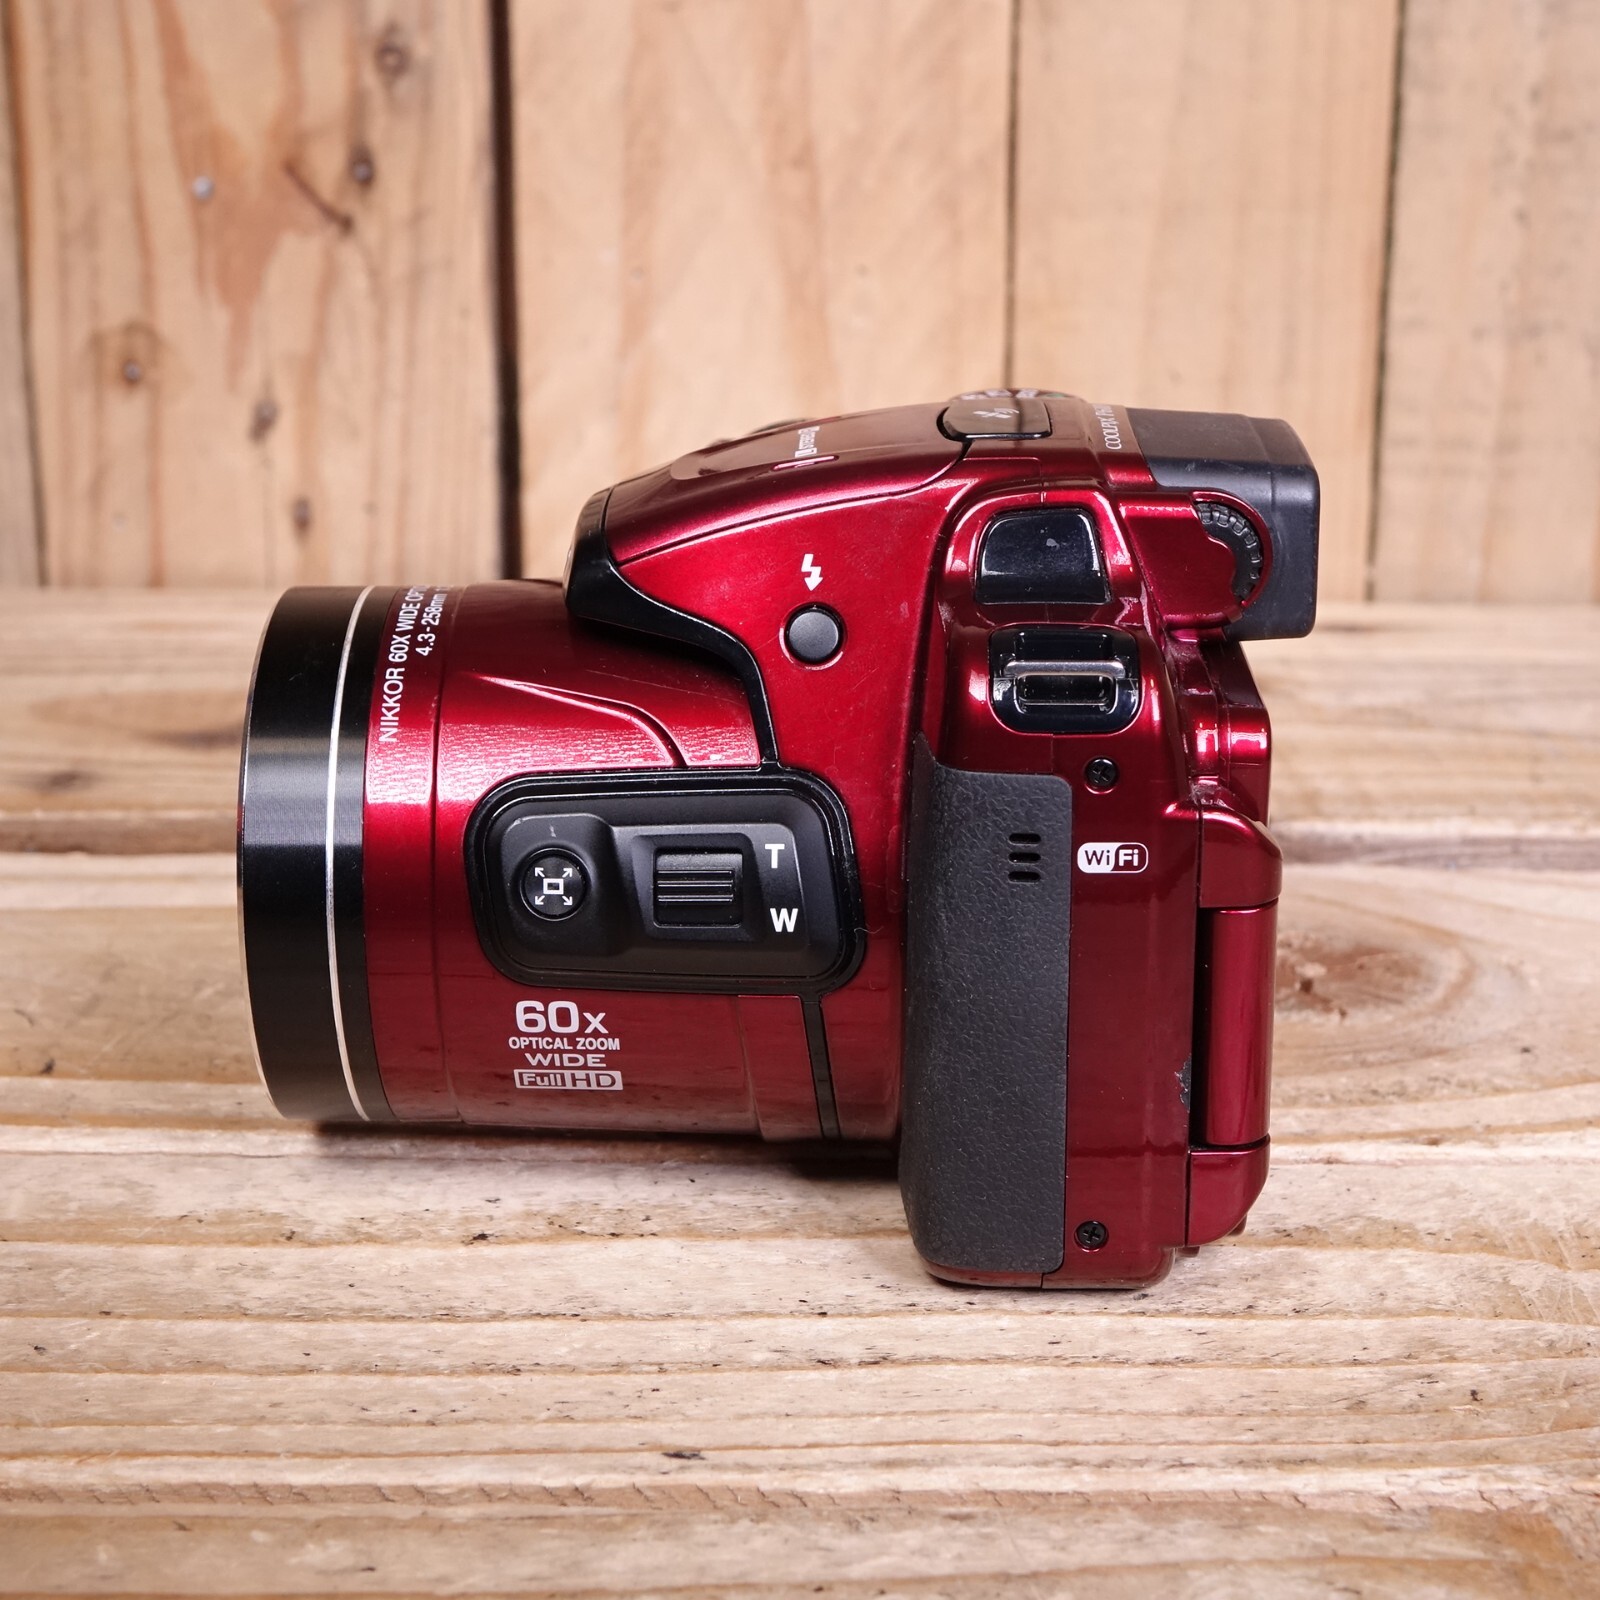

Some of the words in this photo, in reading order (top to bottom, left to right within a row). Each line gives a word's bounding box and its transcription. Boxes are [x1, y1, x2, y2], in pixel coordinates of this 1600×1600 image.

[395, 602, 421, 632] WIDE
[388, 634, 412, 663] 60X
[379, 667, 406, 743] NIKKOR
[764, 843, 785, 869] T
[769, 907, 799, 933] W
[515, 1000, 609, 1034] 60x
[508, 1036, 574, 1050] OPTICAL
[575, 1037, 621, 1051] ZOOM
[524, 1052, 607, 1067] WIDE
